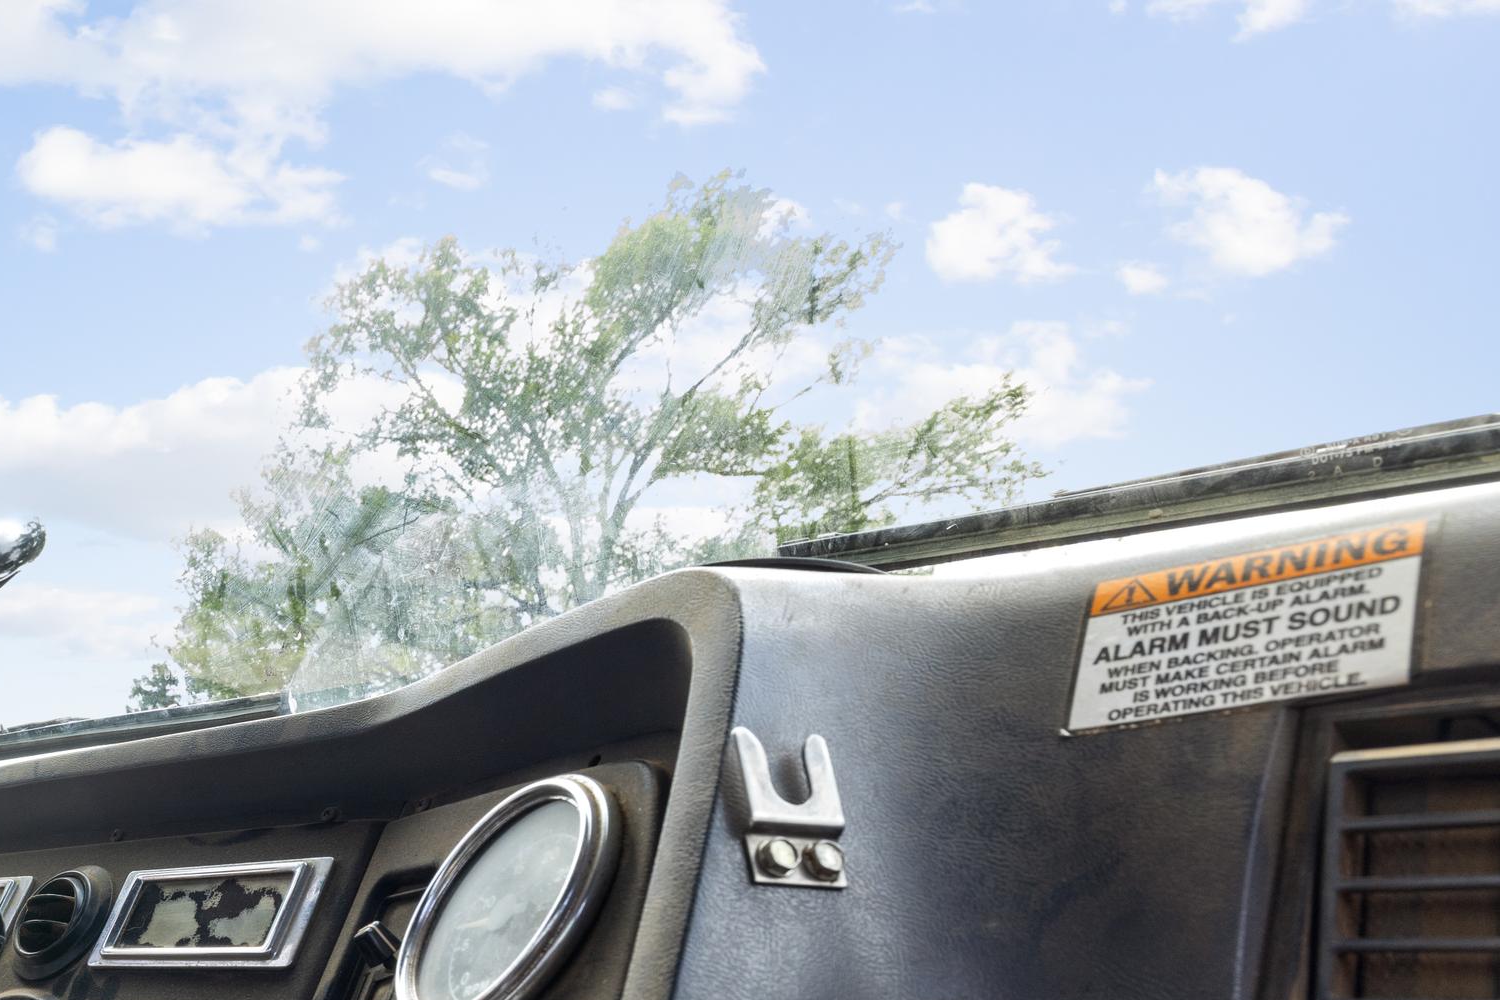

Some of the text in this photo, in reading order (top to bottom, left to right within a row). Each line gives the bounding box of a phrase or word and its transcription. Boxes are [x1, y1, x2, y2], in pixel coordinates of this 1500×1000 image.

[1167, 529, 1408, 595] WARNING
[1121, 567, 1383, 625] THIS VEHICLE IS EQUIPPED
[1126, 584, 1370, 637] WITH A BACK-UP ALARM.
[1092, 595, 1401, 665] ALARM MUST SOUND
[1107, 660, 1161, 678] WHEN
[1264, 623, 1381, 652] OPERATOR
[1099, 638, 1385, 694] MUST MAKE CERTAIN ALARM
[1133, 660, 1339, 703] IS WORKING BEFORE
[1108, 672, 1367, 721] OPERATING THIS VEHICLE.
